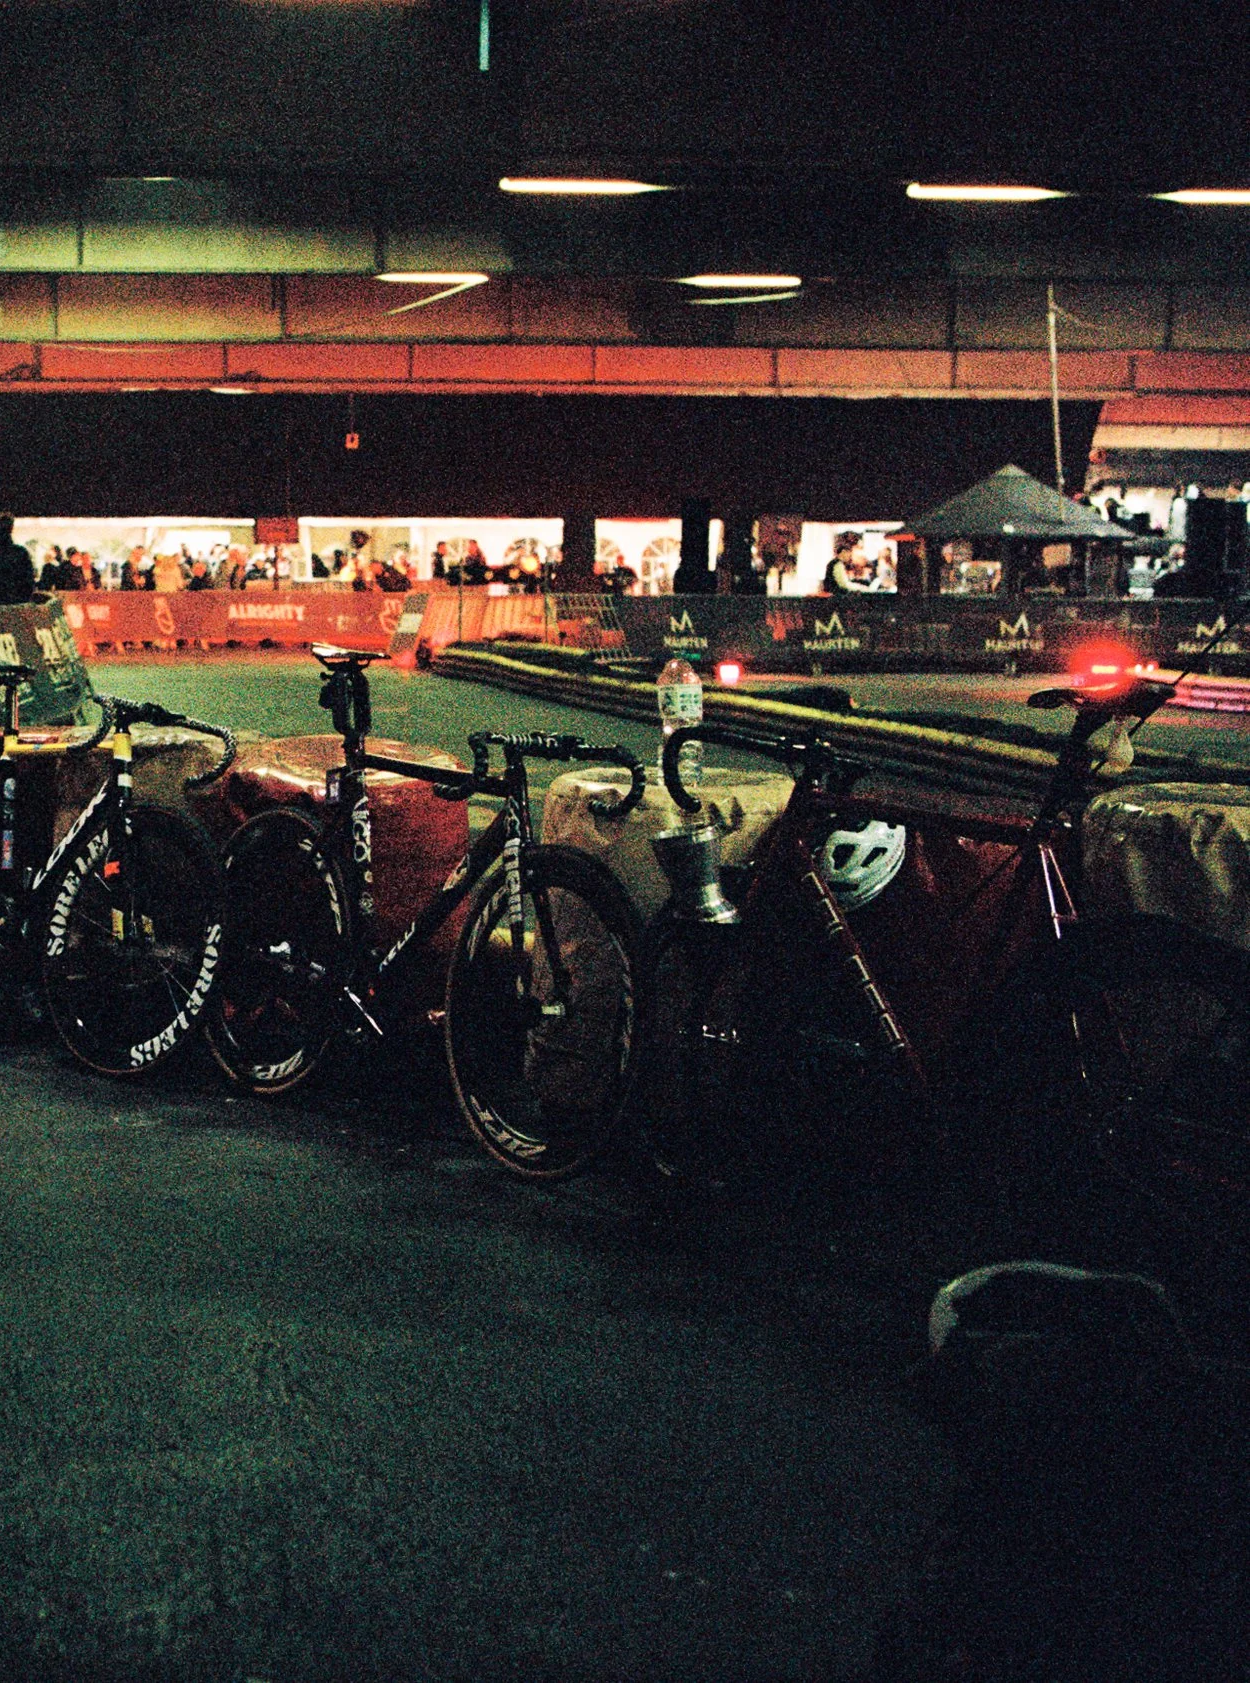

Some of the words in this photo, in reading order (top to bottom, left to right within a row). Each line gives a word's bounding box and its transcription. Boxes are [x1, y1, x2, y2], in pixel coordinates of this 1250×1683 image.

[32, 778, 109, 890] LOOK
[47, 869, 81, 956] SORE
[184, 924, 222, 1016] SORE
[130, 1011, 190, 1067] LEGS
